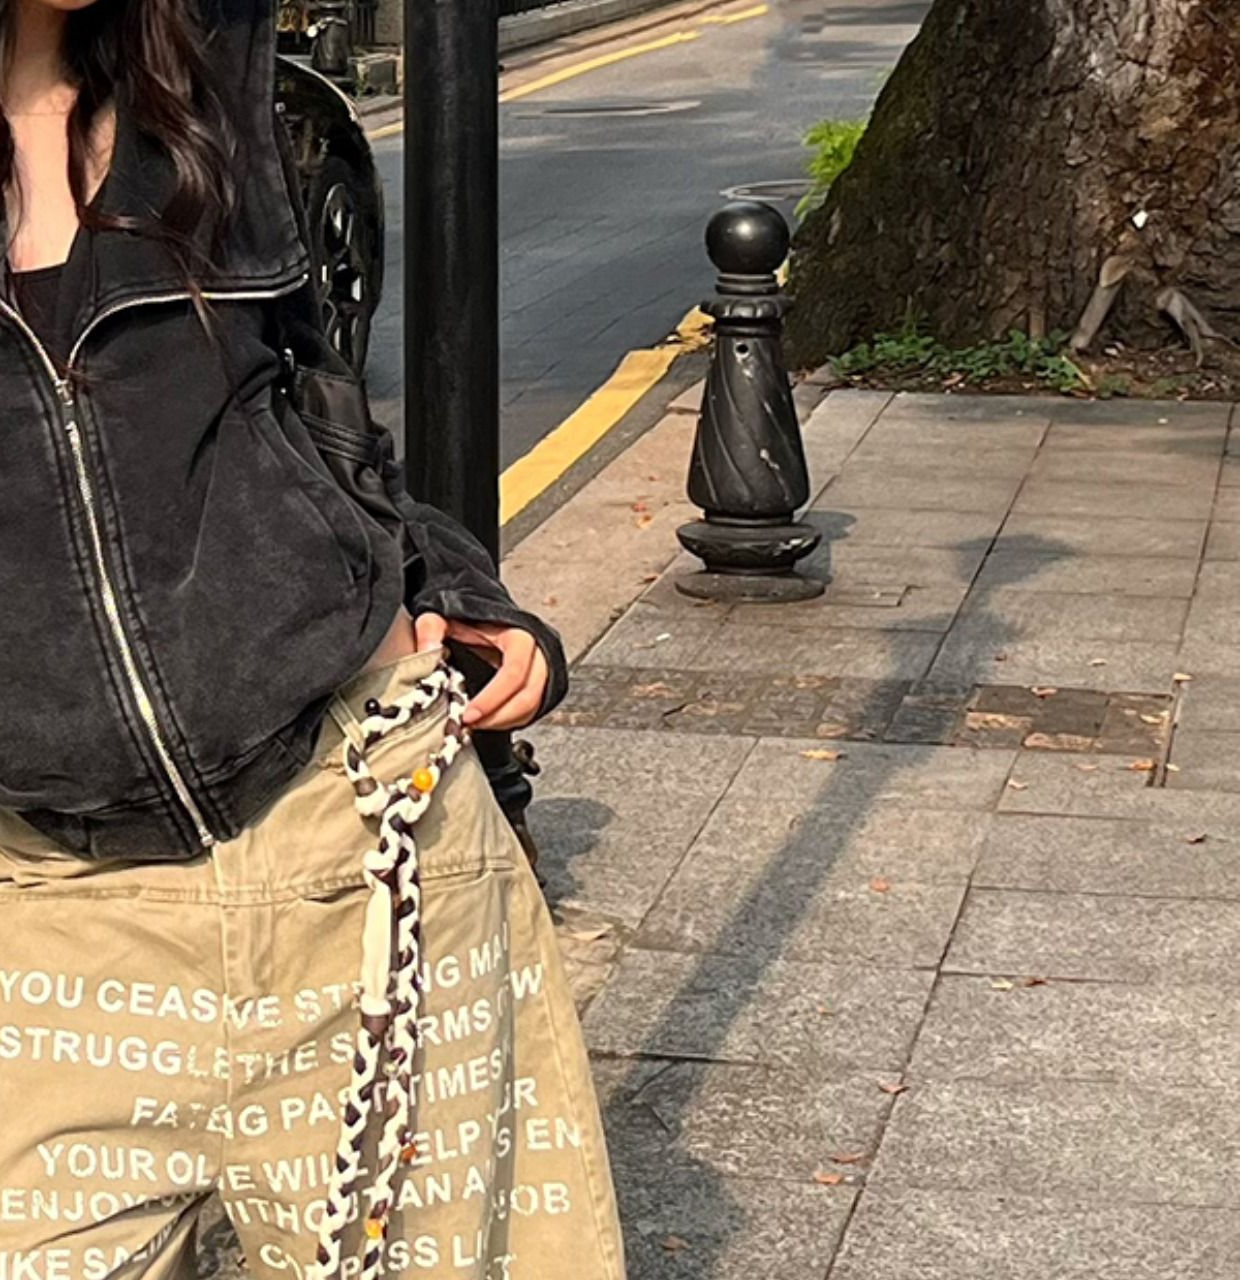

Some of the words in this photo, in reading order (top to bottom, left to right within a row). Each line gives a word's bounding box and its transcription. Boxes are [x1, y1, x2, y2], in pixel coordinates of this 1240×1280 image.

[37, 1142, 158, 1183] YOUR
[262, 1153, 367, 1194] WIL
[395, 1170, 452, 1212] AN
